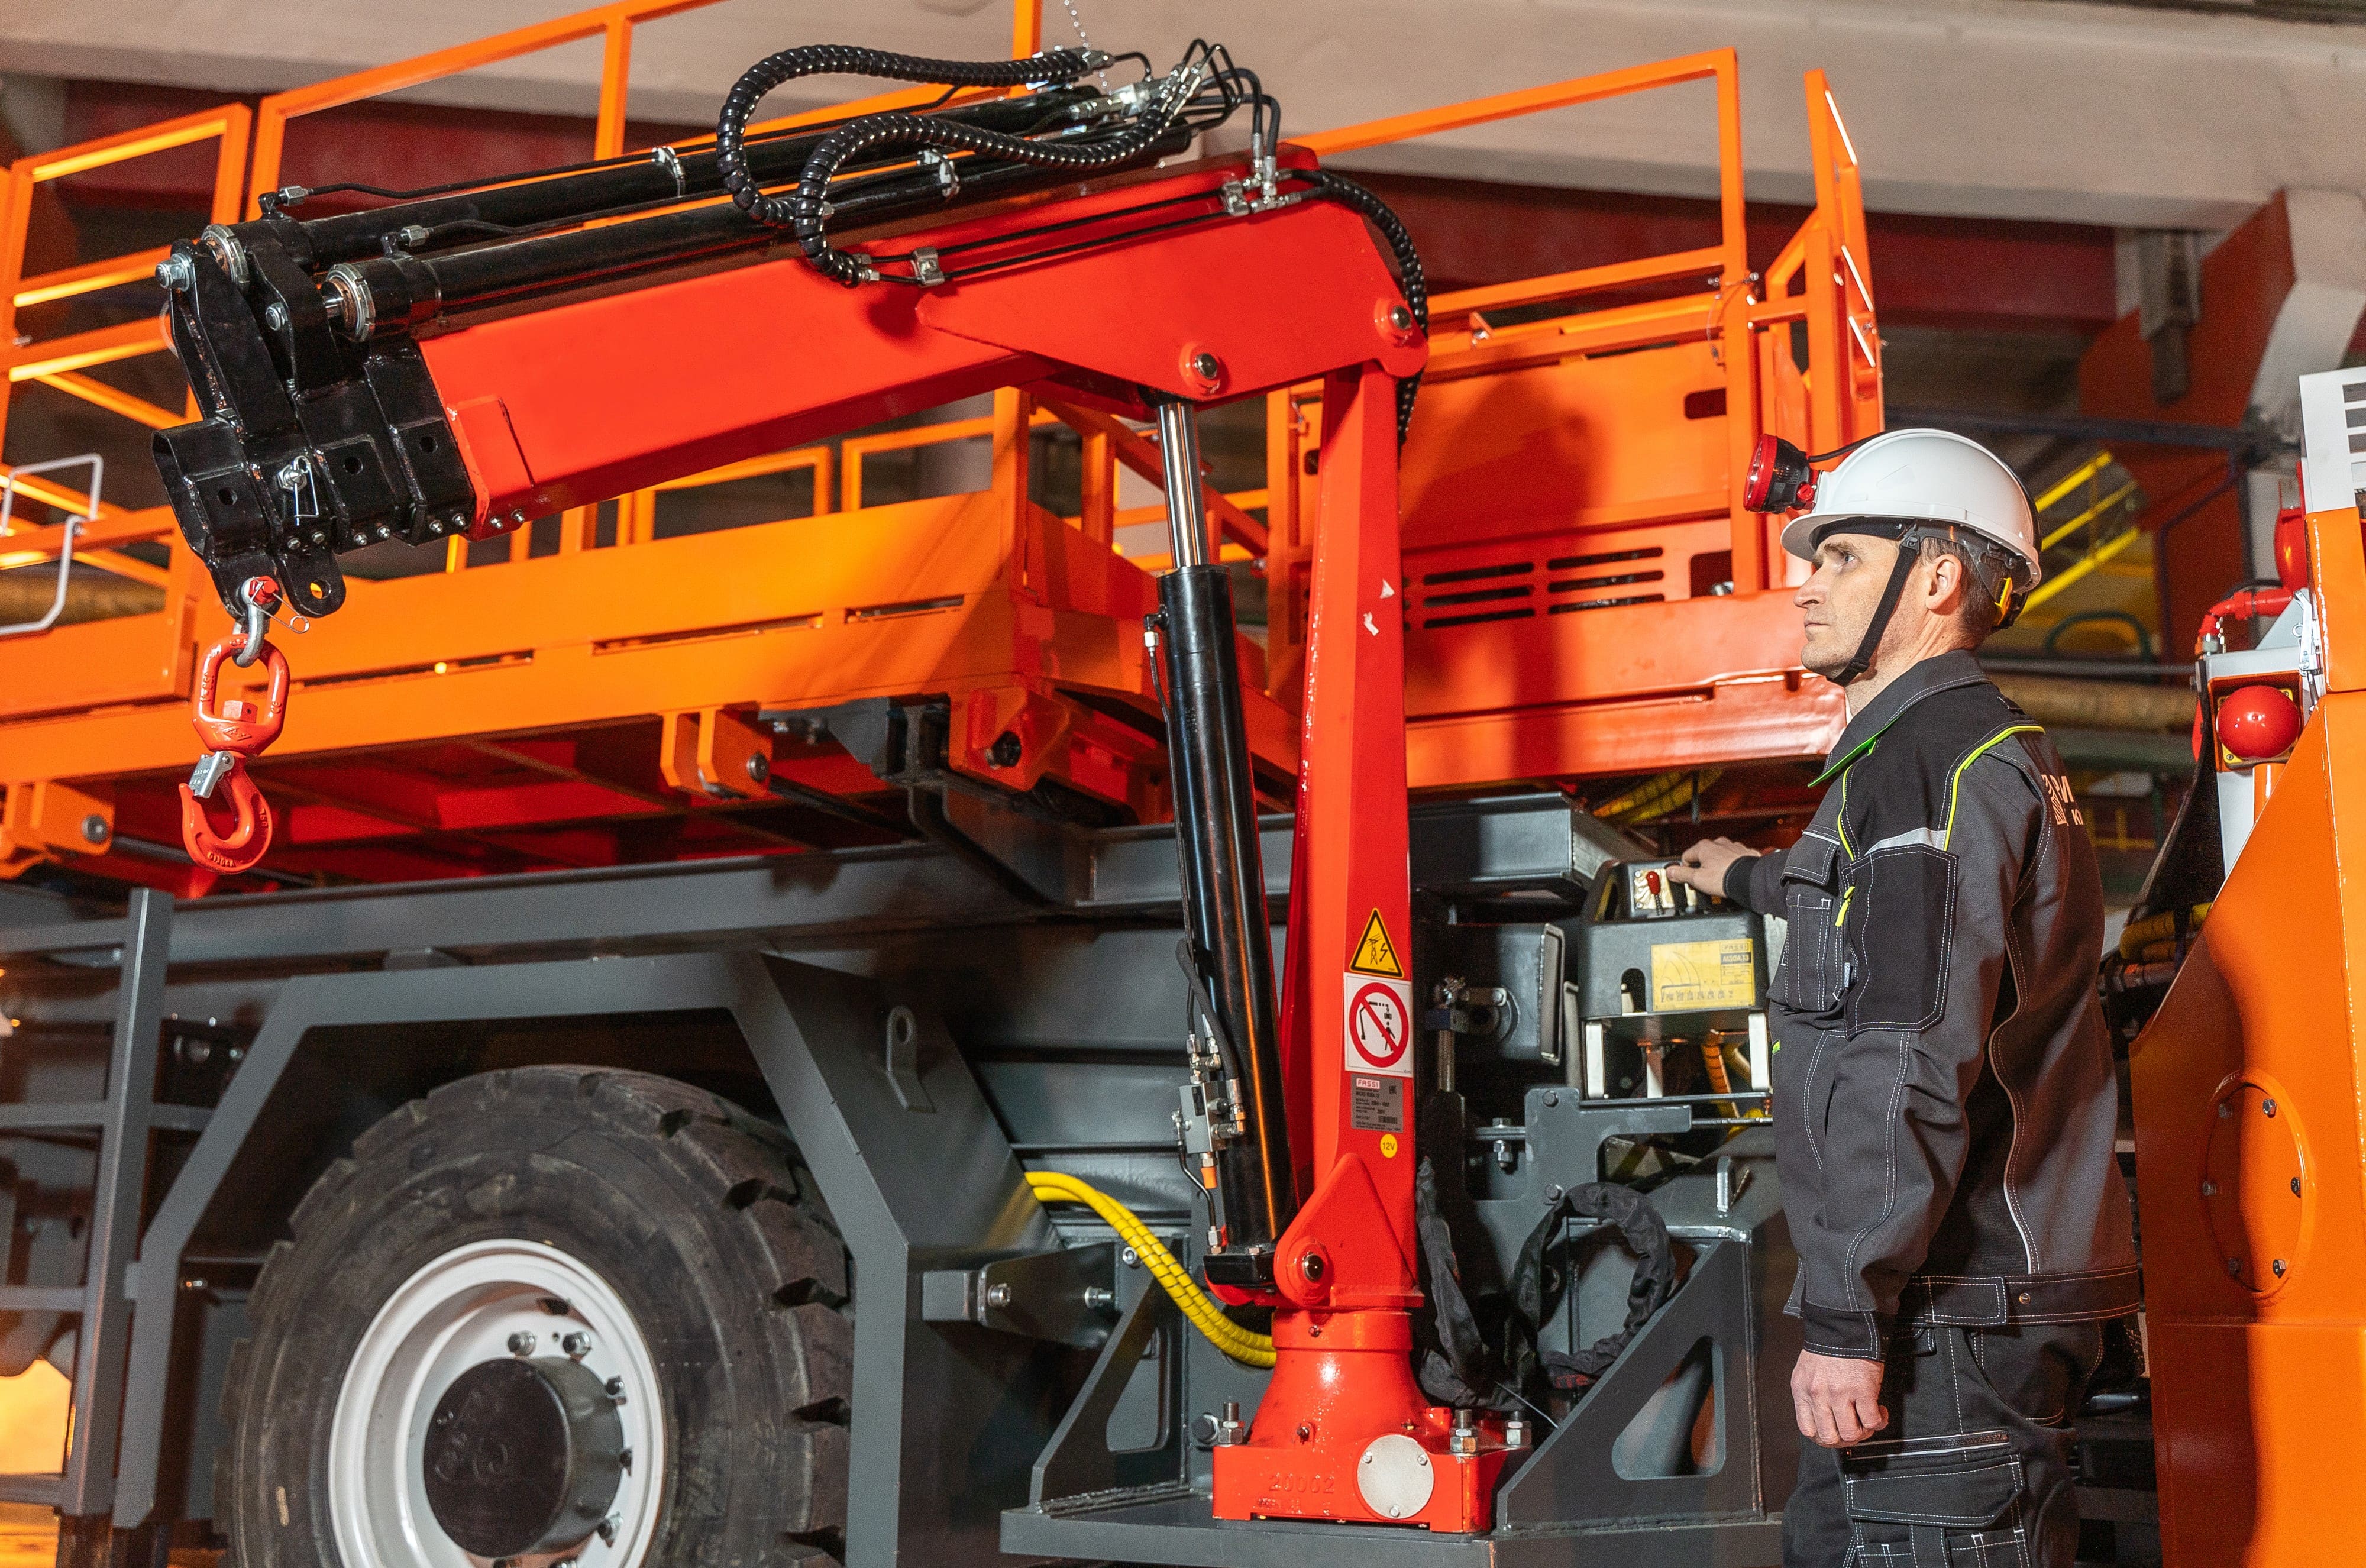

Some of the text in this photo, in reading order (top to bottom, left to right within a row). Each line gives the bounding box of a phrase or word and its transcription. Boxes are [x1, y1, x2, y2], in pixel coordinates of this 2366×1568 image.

[1357, 1079, 1379, 1088] FASSI
[1382, 1142, 1395, 1150] 12V
[1269, 1473, 1334, 1494] 20002
